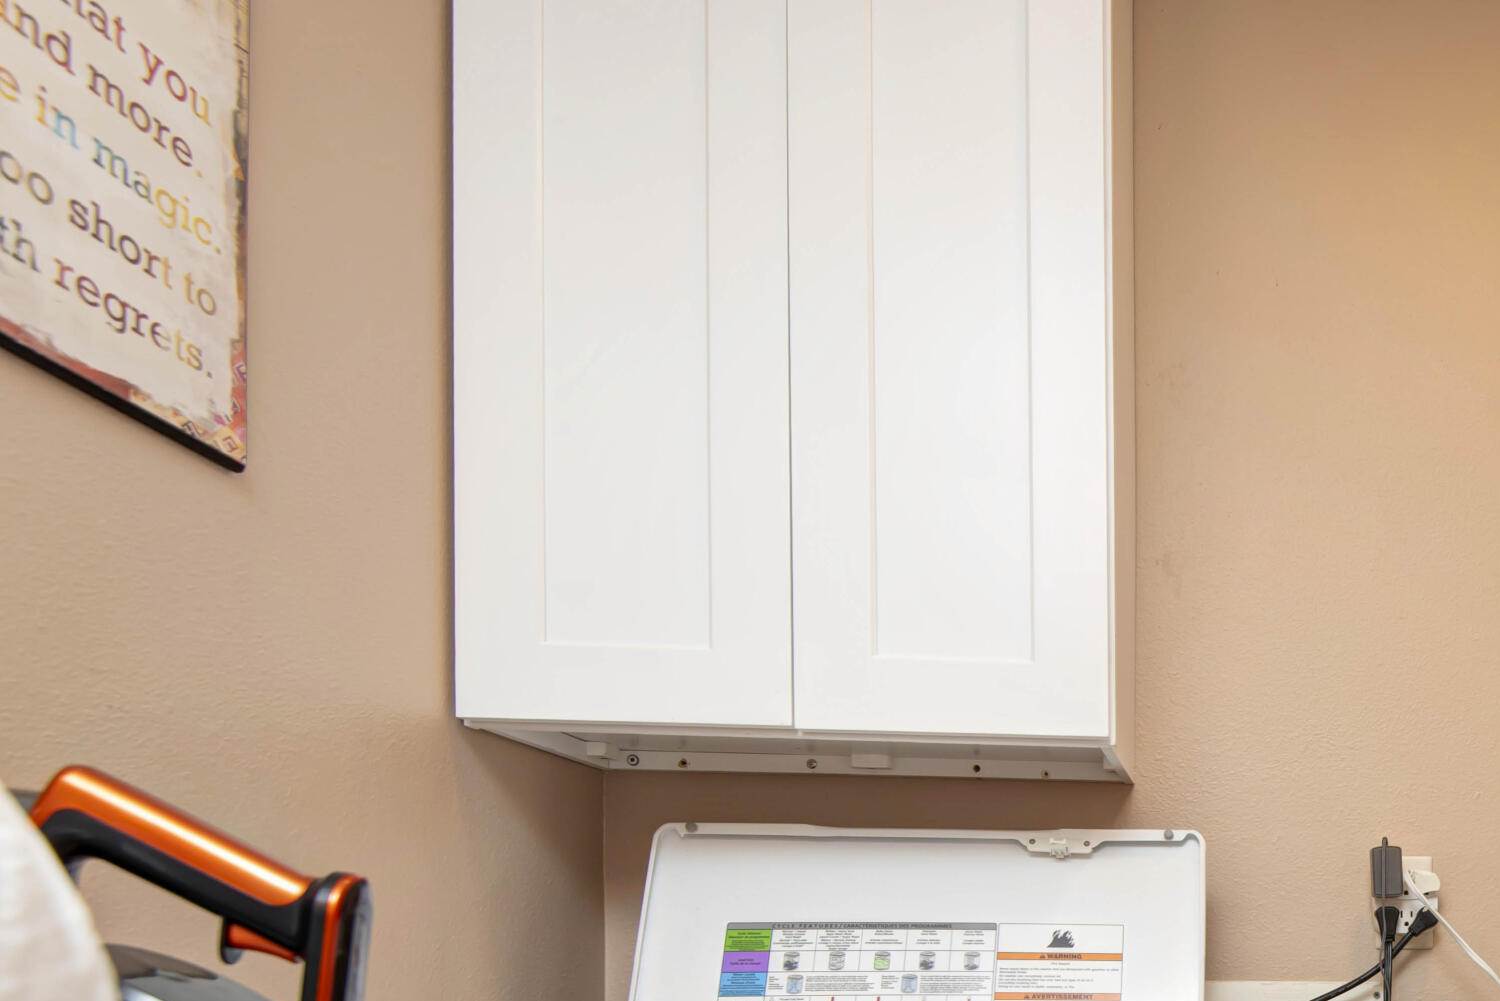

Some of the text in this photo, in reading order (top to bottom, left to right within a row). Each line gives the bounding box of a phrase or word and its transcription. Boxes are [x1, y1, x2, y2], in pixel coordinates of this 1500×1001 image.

[87, 63, 202, 178] more.
[138, 42, 210, 126] you
[35, 85, 80, 150] in
[91, 136, 221, 254] magic.
[67, 198, 172, 290] short
[184, 271, 216, 316] to
[53, 258, 213, 379] regrets.
